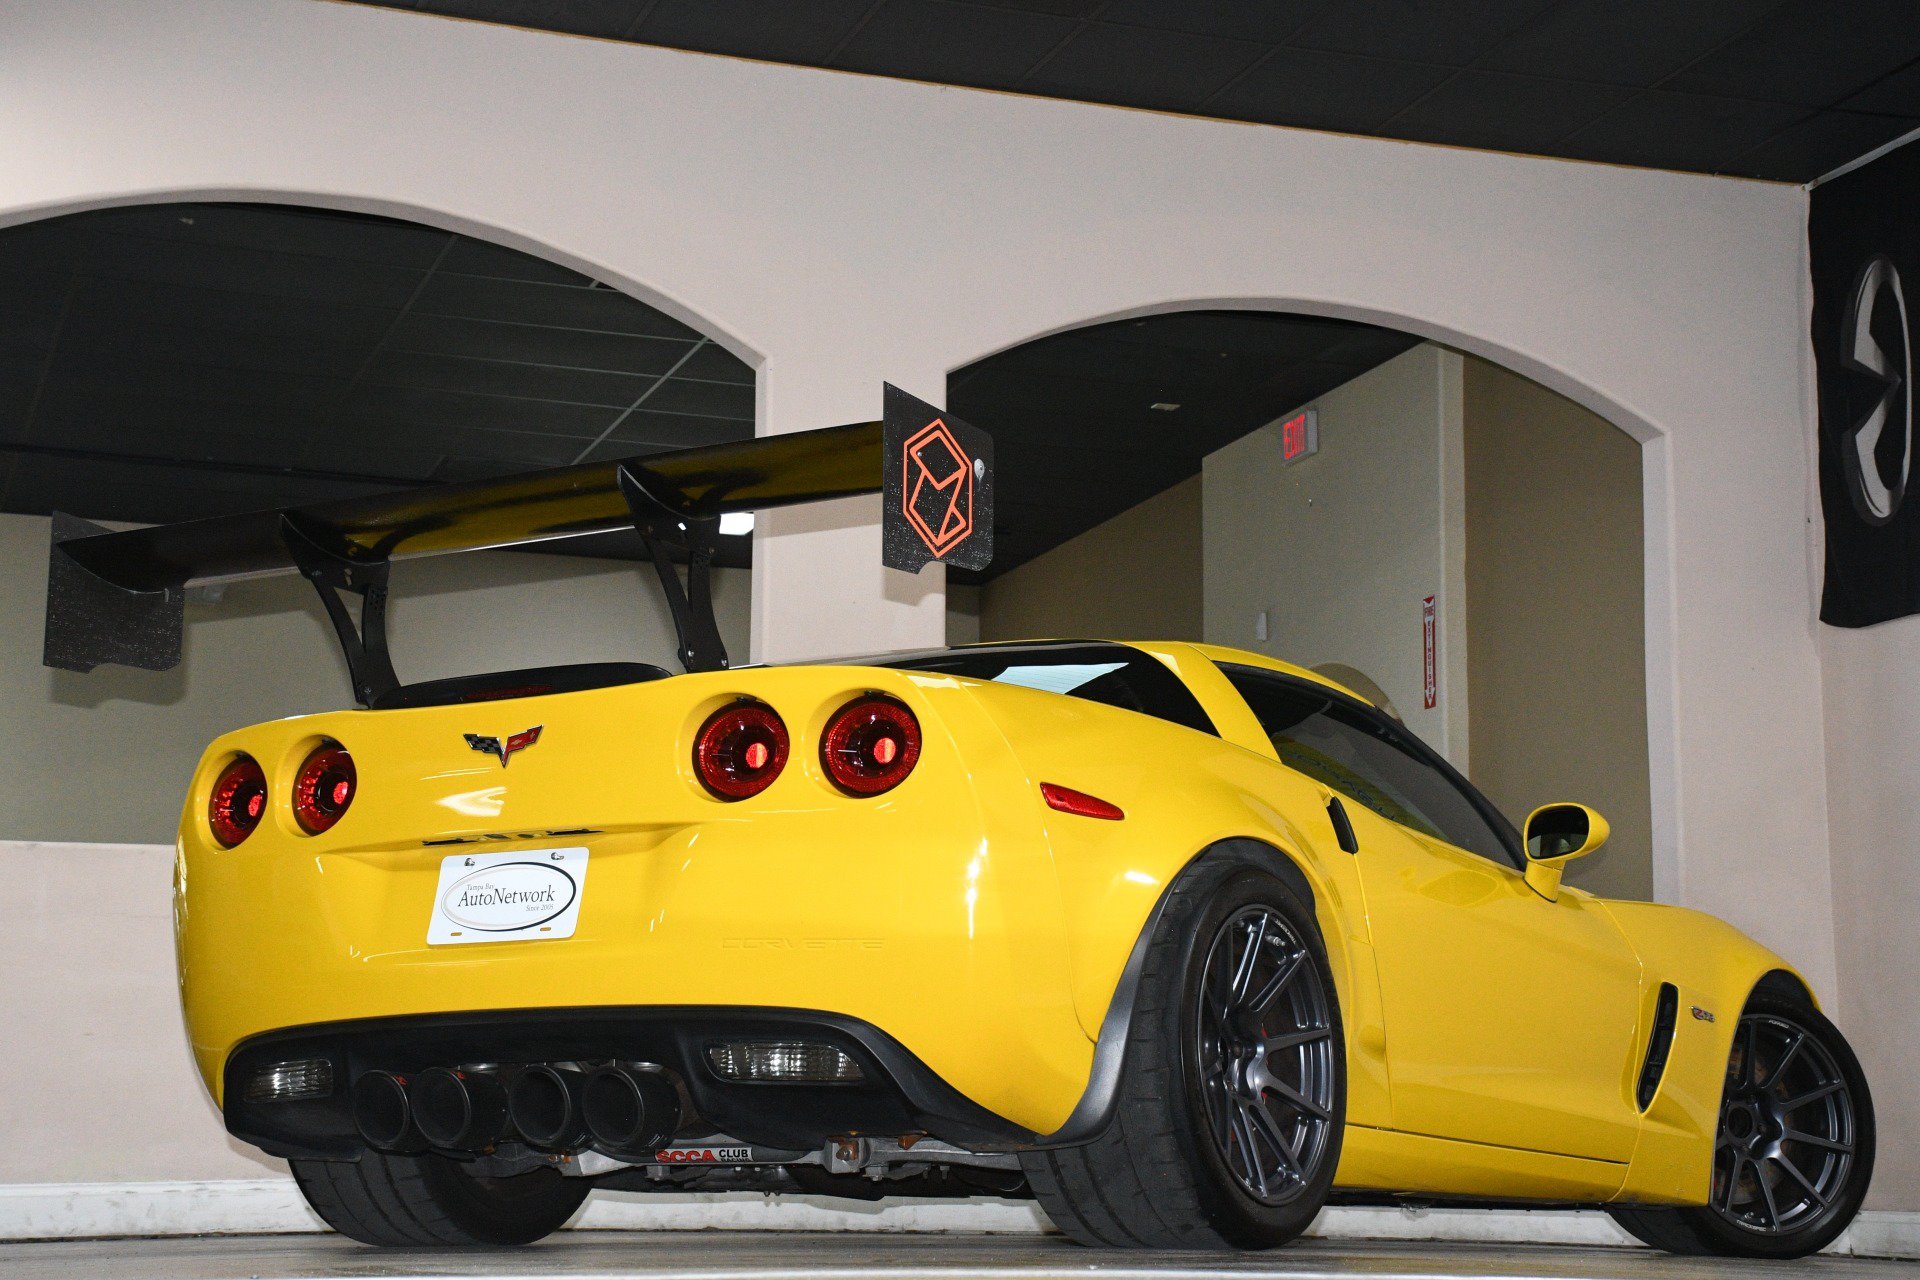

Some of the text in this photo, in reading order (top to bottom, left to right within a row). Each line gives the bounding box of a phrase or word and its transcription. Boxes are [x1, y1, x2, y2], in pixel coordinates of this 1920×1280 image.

[1283, 414, 1305, 460] EXIT
[458, 885, 555, 907] AutoNetwork
[722, 937, 886, 950] CORVETTE
[656, 1149, 748, 1163] SCCA CLUB
